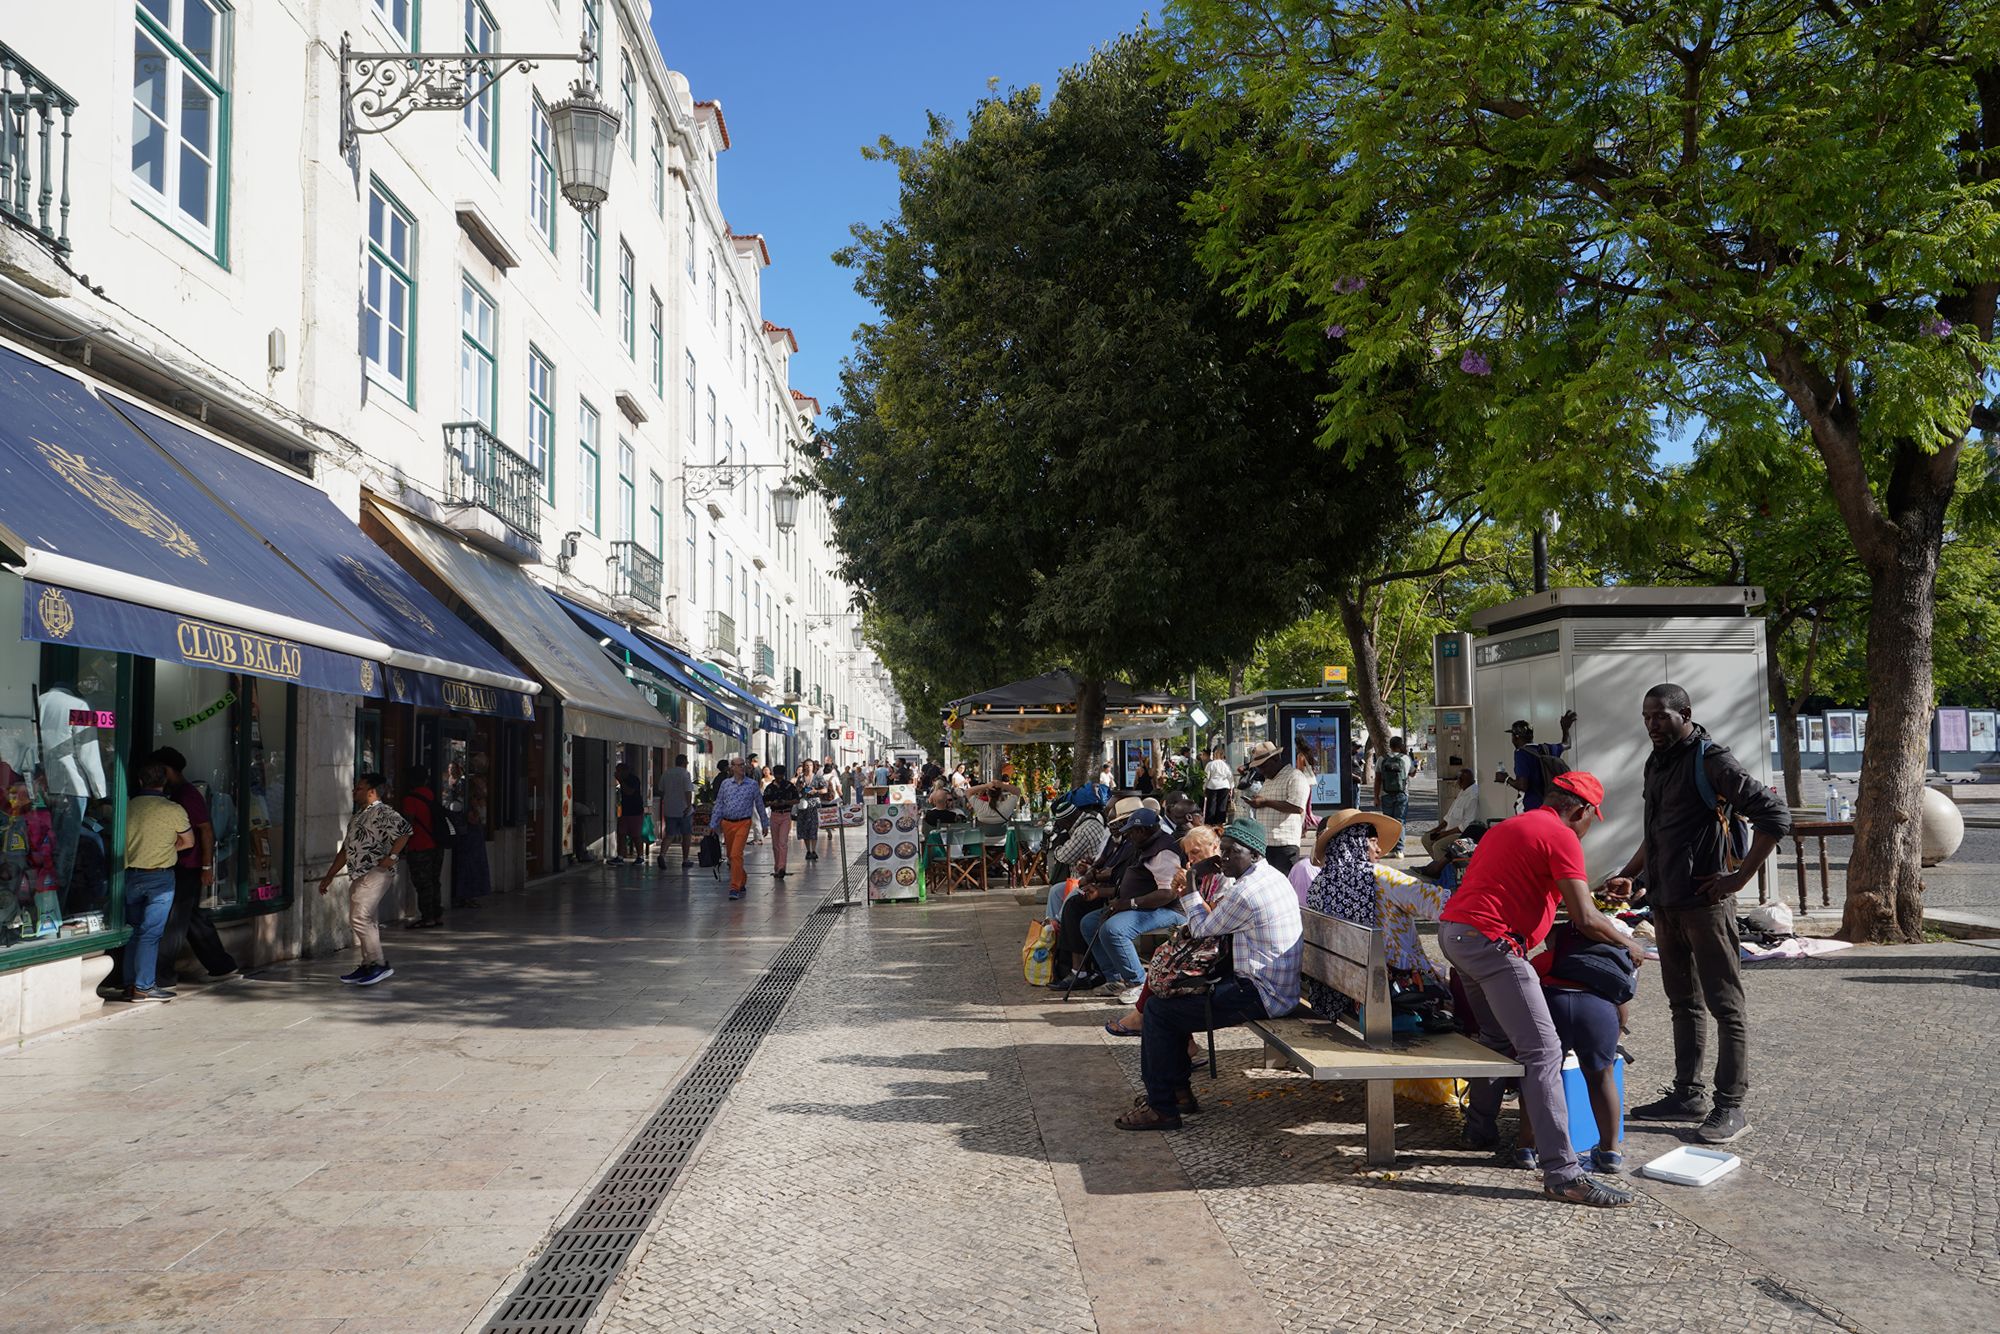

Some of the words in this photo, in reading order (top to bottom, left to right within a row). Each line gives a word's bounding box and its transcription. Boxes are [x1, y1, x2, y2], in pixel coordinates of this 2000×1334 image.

[177, 622, 237, 664] CLUB
[240, 636, 302, 677] BALÃO
[442, 682, 468, 706] CLUB
[69, 711, 116, 727] SALDOS
[173, 692, 236, 731] SALDOS
